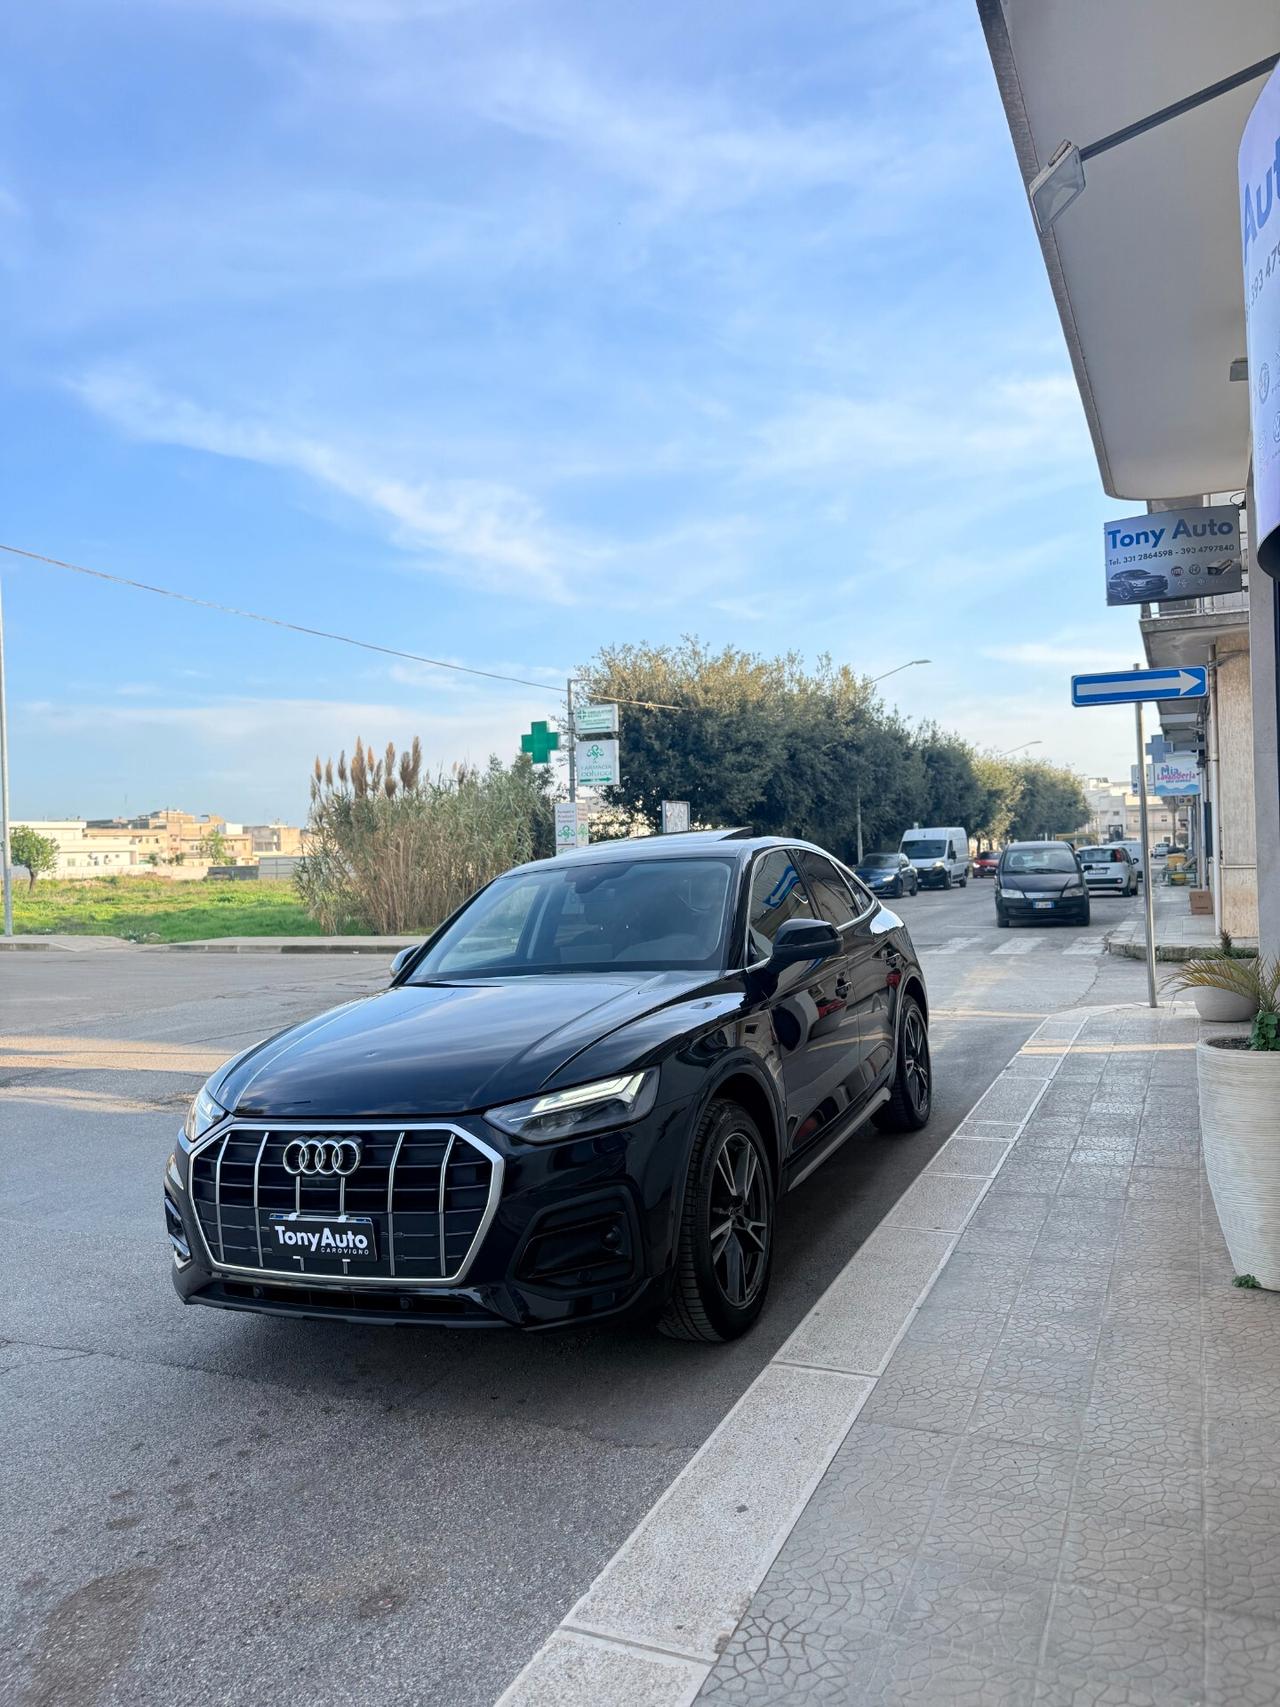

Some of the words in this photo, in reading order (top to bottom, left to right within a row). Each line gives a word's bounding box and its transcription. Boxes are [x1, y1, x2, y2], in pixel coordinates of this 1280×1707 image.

[1107, 527, 1166, 549] Tony
[1171, 518, 1234, 540] Auto
[1138, 549, 1173, 561] 2864598
[1181, 547, 1196, 555] 393
[1160, 765, 1179, 775] Mia
[1156, 771, 1196, 781] Lavanderia
[320, 1247, 369, 1255] CAROVIGNO
